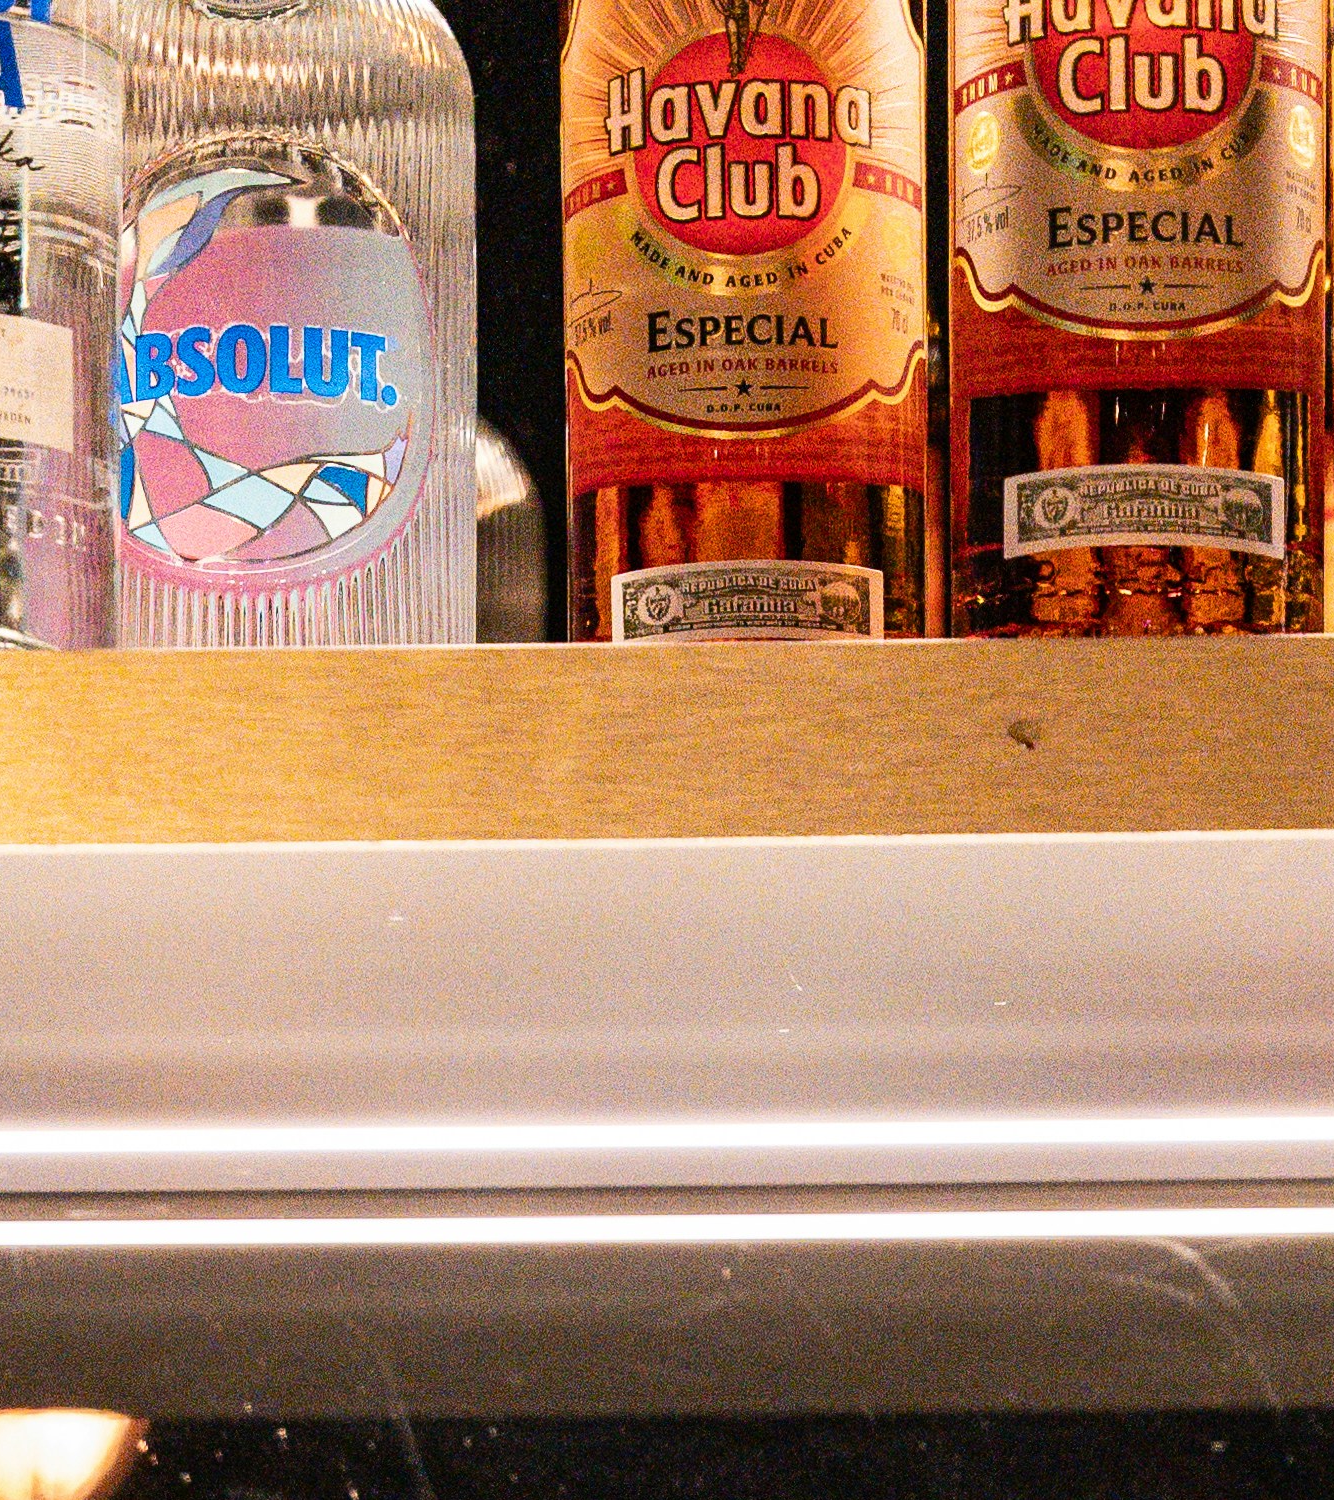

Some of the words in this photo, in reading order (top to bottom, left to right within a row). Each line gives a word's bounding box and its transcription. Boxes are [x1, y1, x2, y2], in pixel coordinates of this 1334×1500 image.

[1058, 33, 1228, 114] Club
[605, 67, 872, 156] Havana
[656, 141, 822, 222] Club
[630, 230, 669, 269] MADE
[675, 265, 715, 287] AND
[726, 270, 778, 288] AGED
[788, 262, 808, 282] IN
[816, 226, 853, 267] CUBA
[1046, 206, 1244, 250] ESPECIAL
[646, 310, 839, 354] ESPECIAL
[646, 361, 691, 379] AGED
[697, 360, 715, 374] IN
[722, 357, 757, 374] OAK
[765, 357, 839, 375] BARRELS
